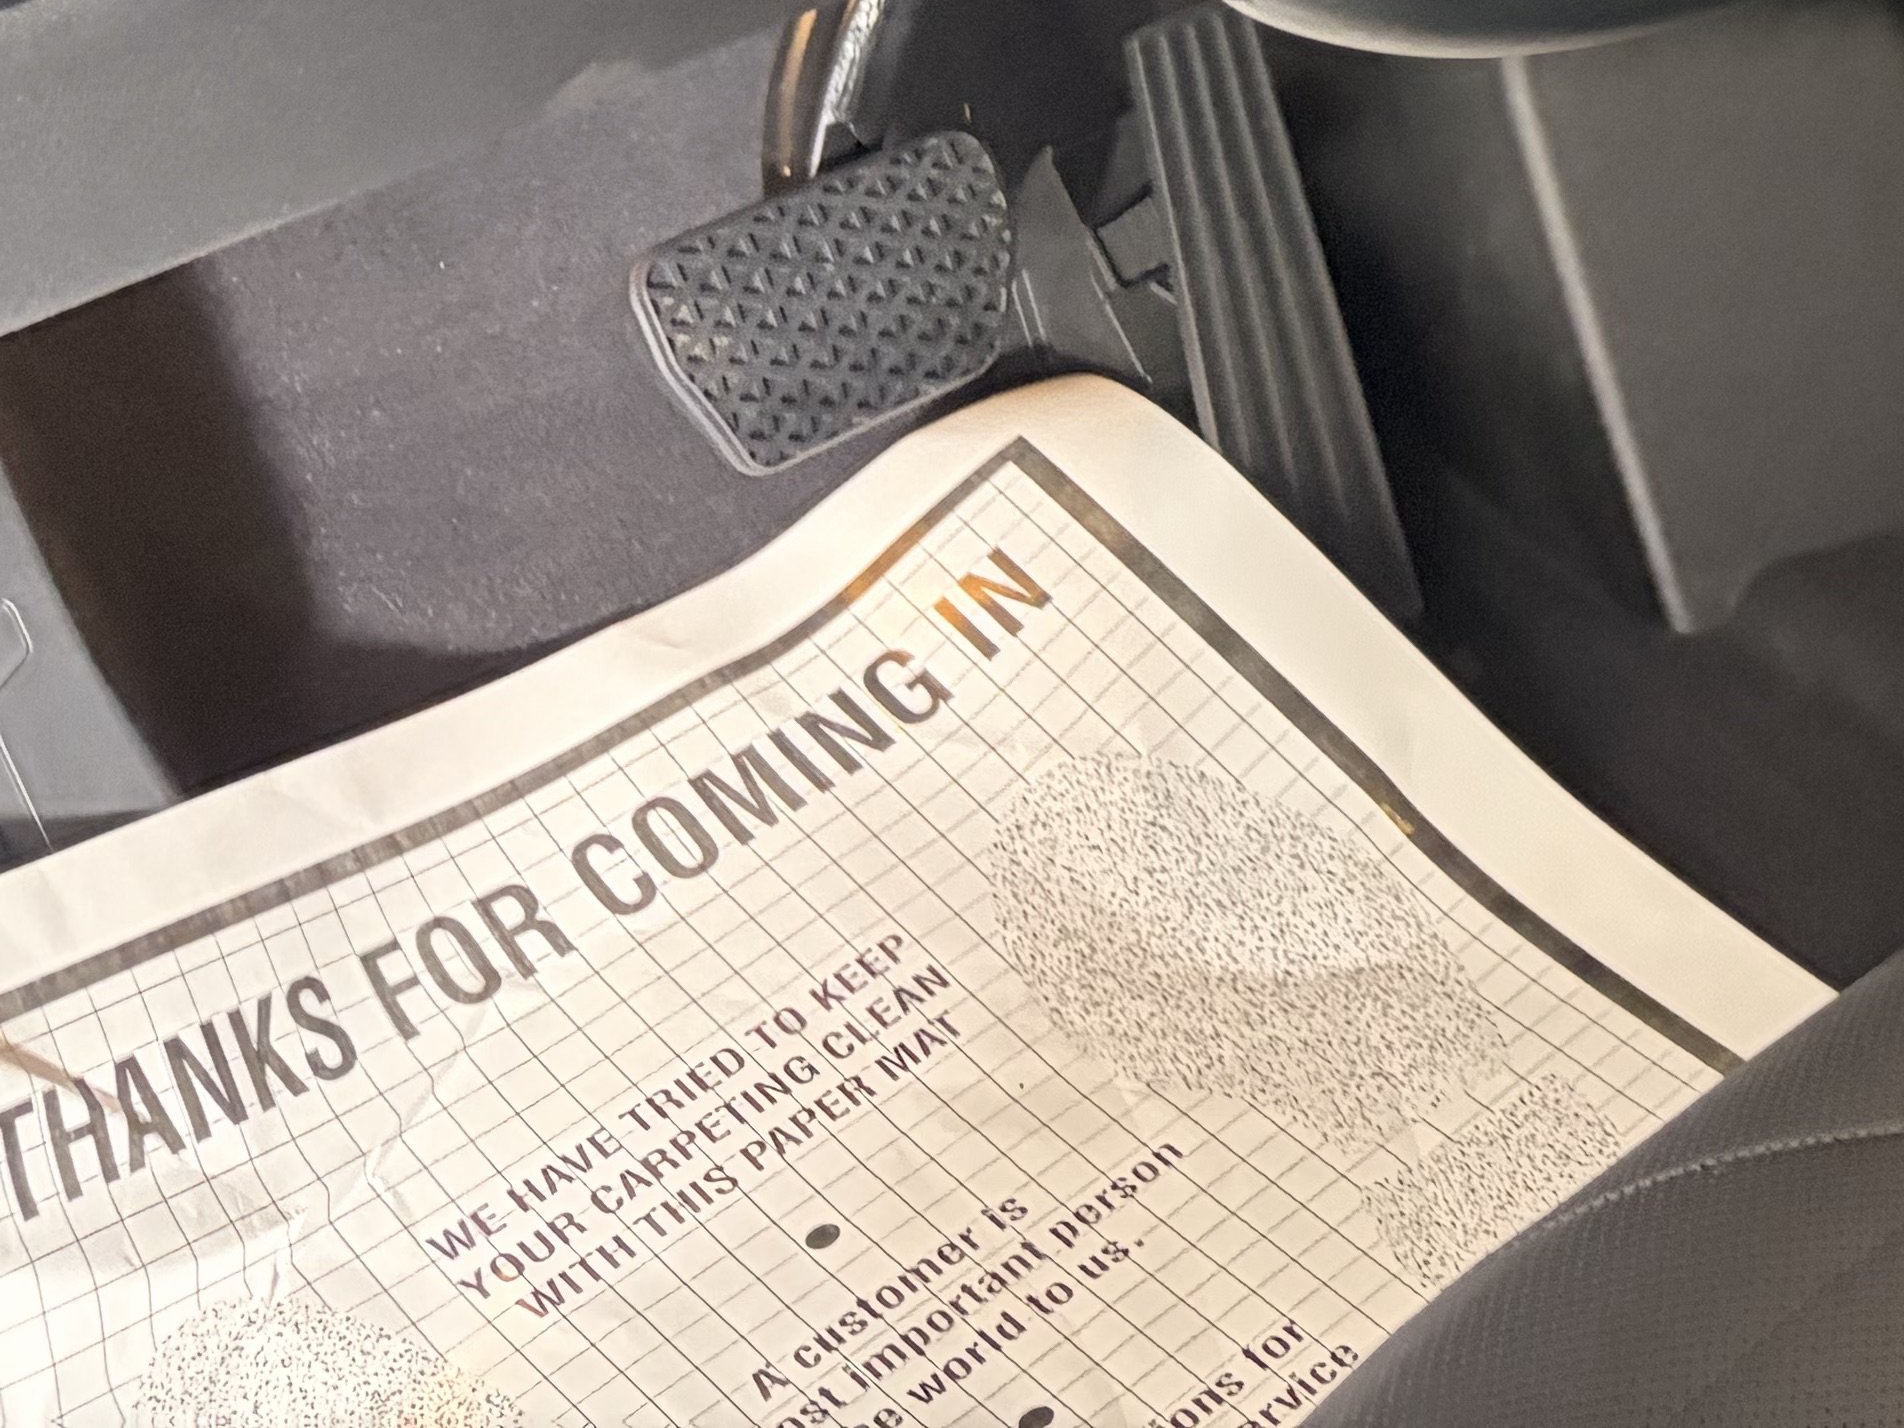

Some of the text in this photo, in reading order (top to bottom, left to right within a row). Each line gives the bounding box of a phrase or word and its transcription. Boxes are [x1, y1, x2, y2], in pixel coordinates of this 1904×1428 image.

[0, 546, 1053, 1222] THANKS FOR COMING IN
[425, 932, 907, 1262] WE HAVE TRIED TO KEEP
[456, 963, 953, 1300] YOUR CARPETING CLEAN
[515, 1010, 962, 1319] WITH THIS PAPER MAT
[751, 1197, 1029, 1402] A customer is
[842, 1241, 1048, 1392] important
[1049, 1142, 1185, 1250] person
[907, 1310, 1028, 1406] world
[1025, 1281, 1075, 1315] to
[1078, 1238, 1147, 1280] us.
[1242, 1318, 1305, 1371] for
